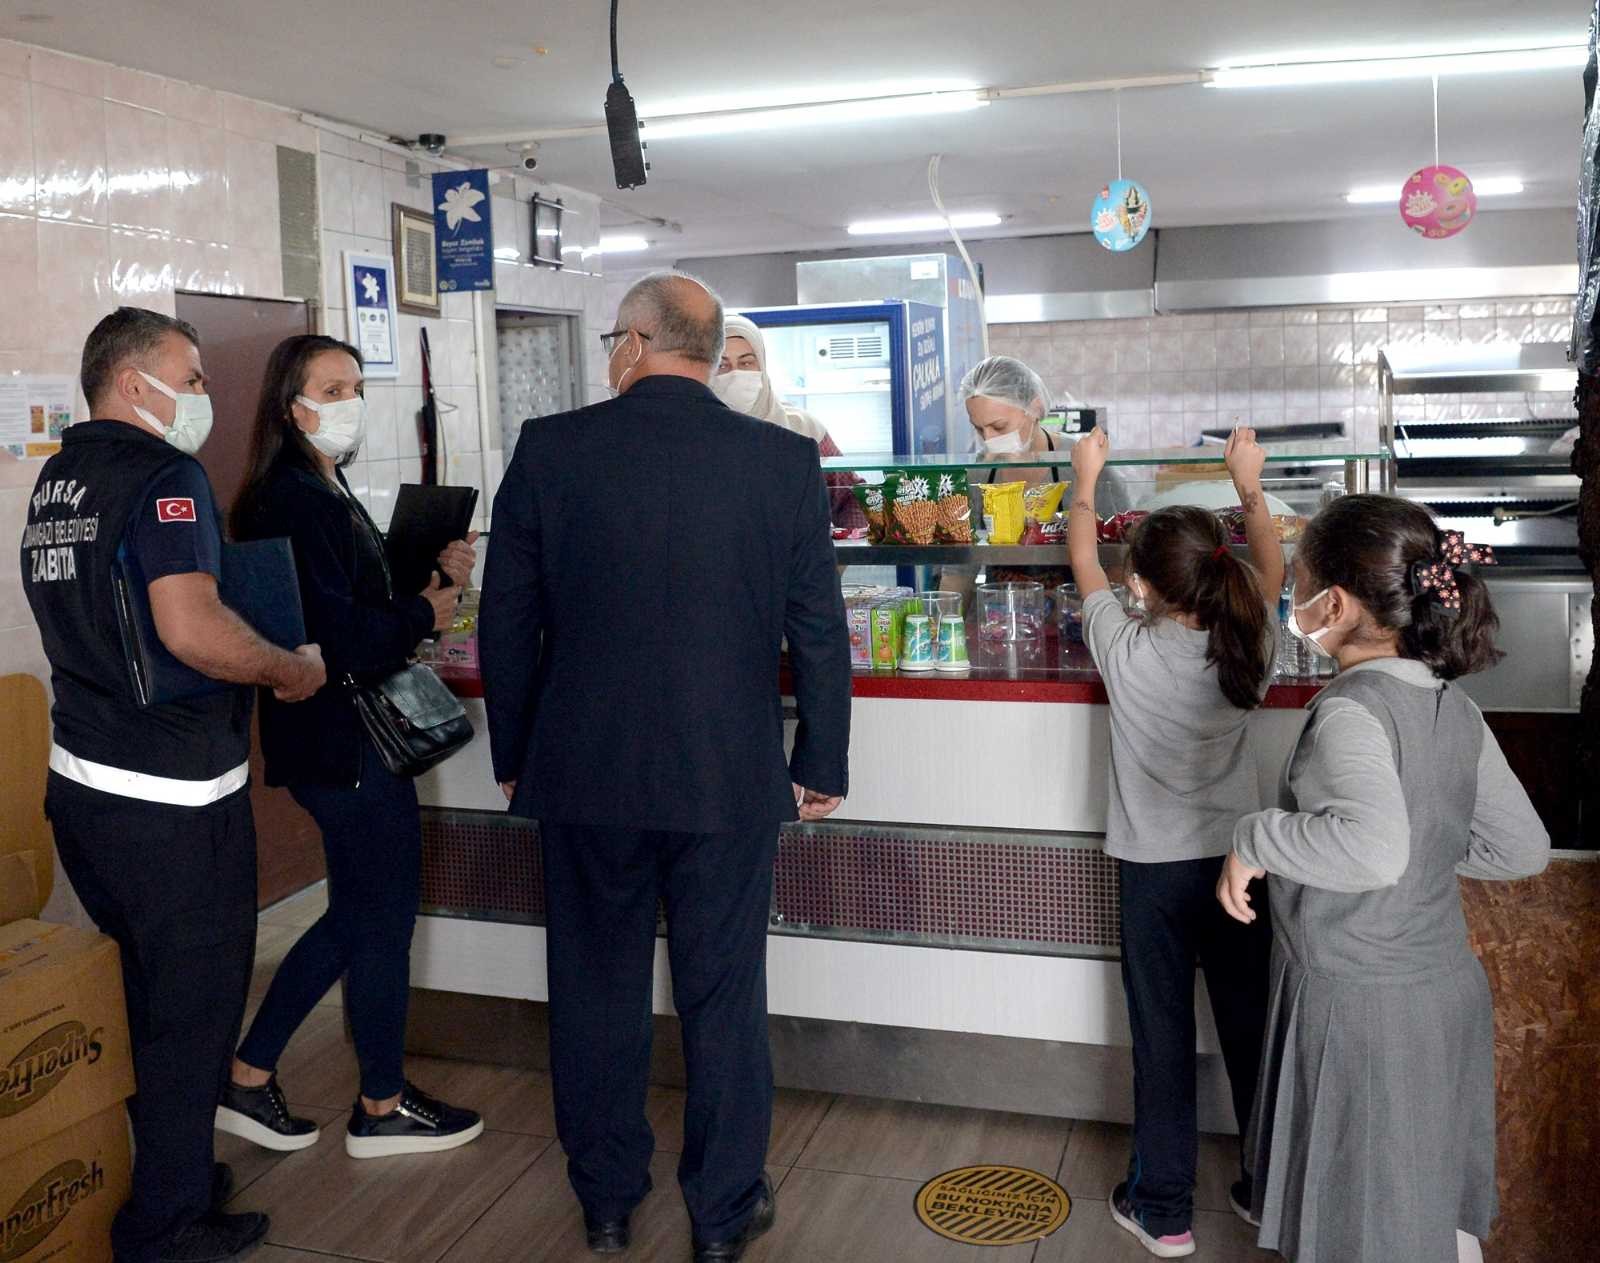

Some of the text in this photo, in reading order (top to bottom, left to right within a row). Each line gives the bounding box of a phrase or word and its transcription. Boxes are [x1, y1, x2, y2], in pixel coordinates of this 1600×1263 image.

[32, 480, 87, 516] BURSA
[31, 546, 77, 582] ZABITA
[935, 1193, 1052, 1213] BU NOKTADA
